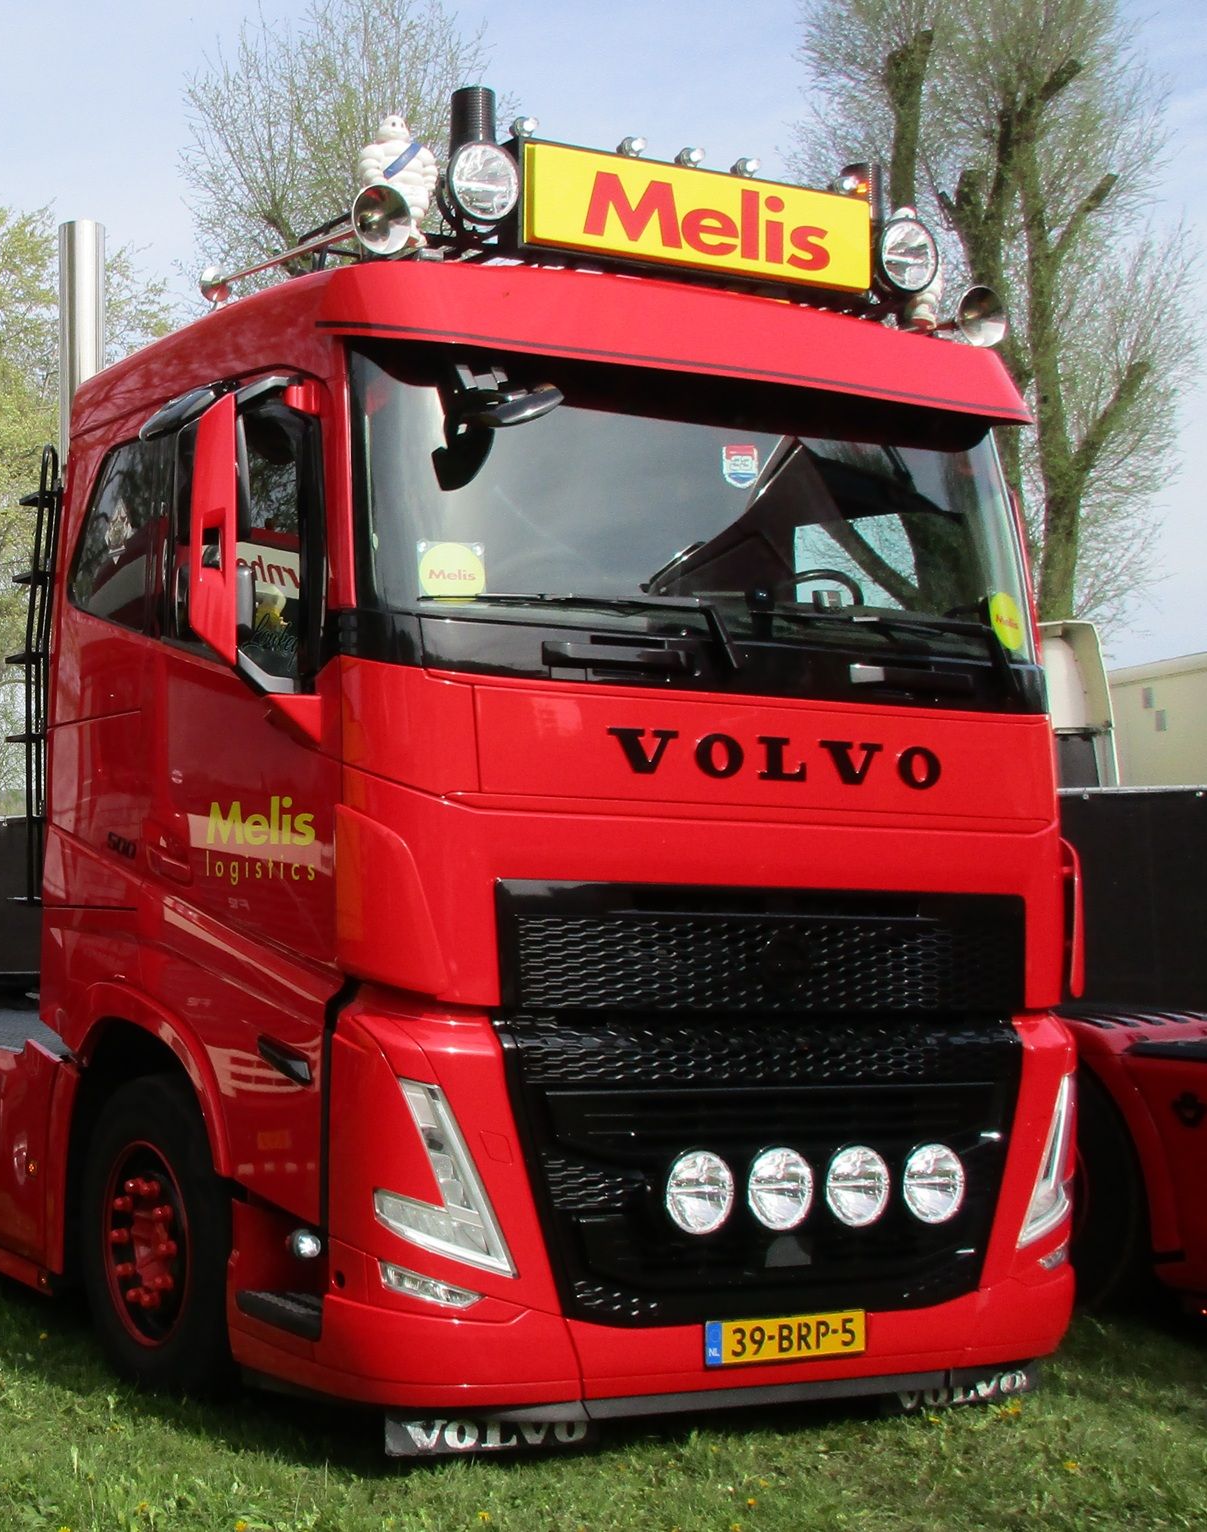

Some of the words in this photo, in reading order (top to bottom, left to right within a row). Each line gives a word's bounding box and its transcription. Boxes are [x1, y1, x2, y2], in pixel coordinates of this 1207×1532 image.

[583, 170, 830, 271] Melis
[427, 568, 477, 582] Melis
[606, 726, 942, 790] VOLVO
[206, 795, 316, 846] Melis
[205, 850, 316, 886] logistics
[708, 1347, 721, 1357] NL
[730, 1317, 856, 1358] 39-BRP-5
[401, 1417, 588, 1450] VOLVO
